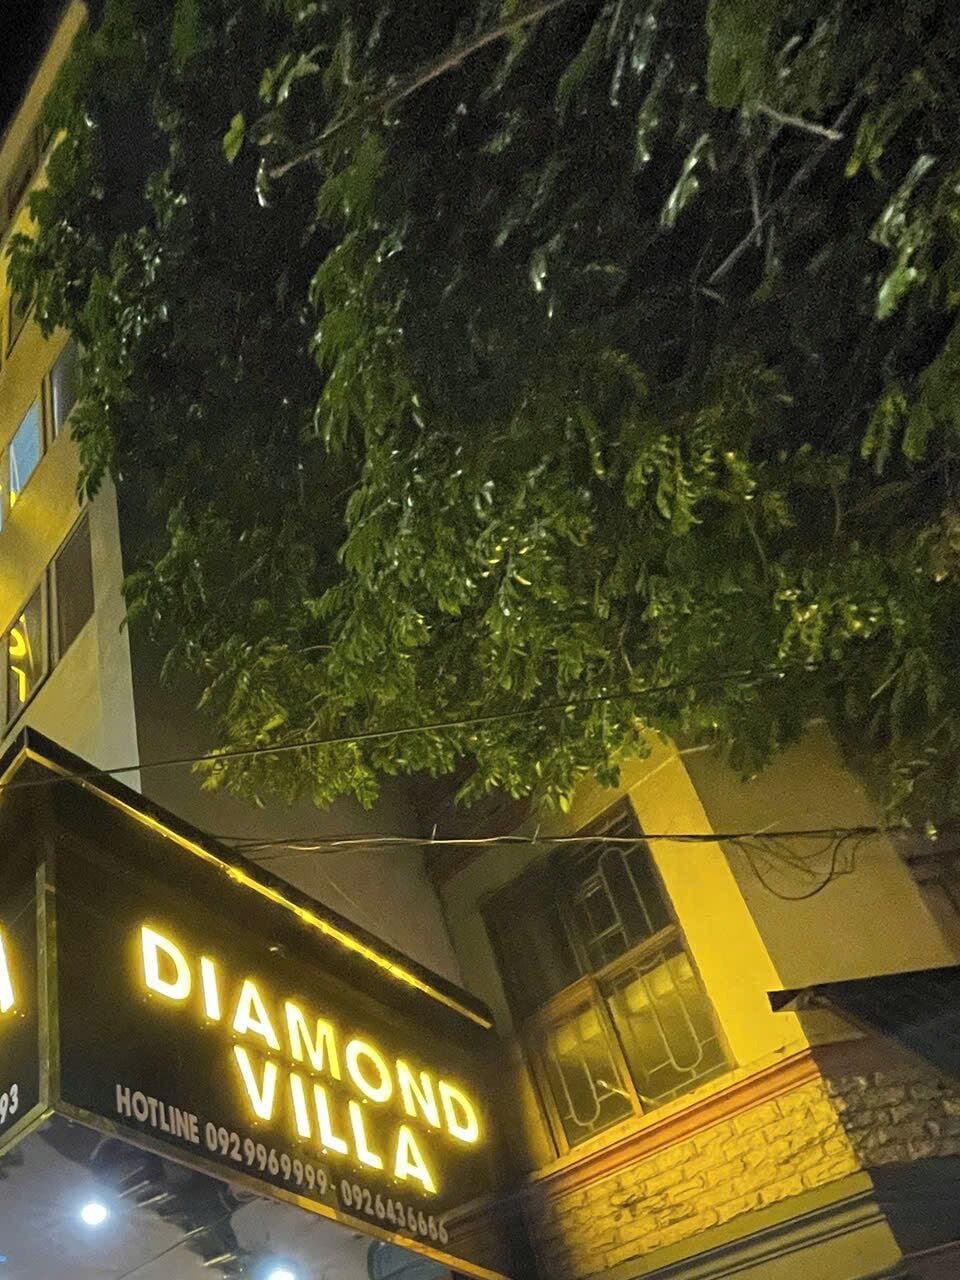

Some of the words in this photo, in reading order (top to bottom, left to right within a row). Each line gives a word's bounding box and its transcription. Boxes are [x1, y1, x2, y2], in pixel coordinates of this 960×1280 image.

[141, 926, 481, 1144] DIAMOND
[116, 1084, 200, 1144] HOTLINE
[234, 1045, 438, 1194] VILLA
